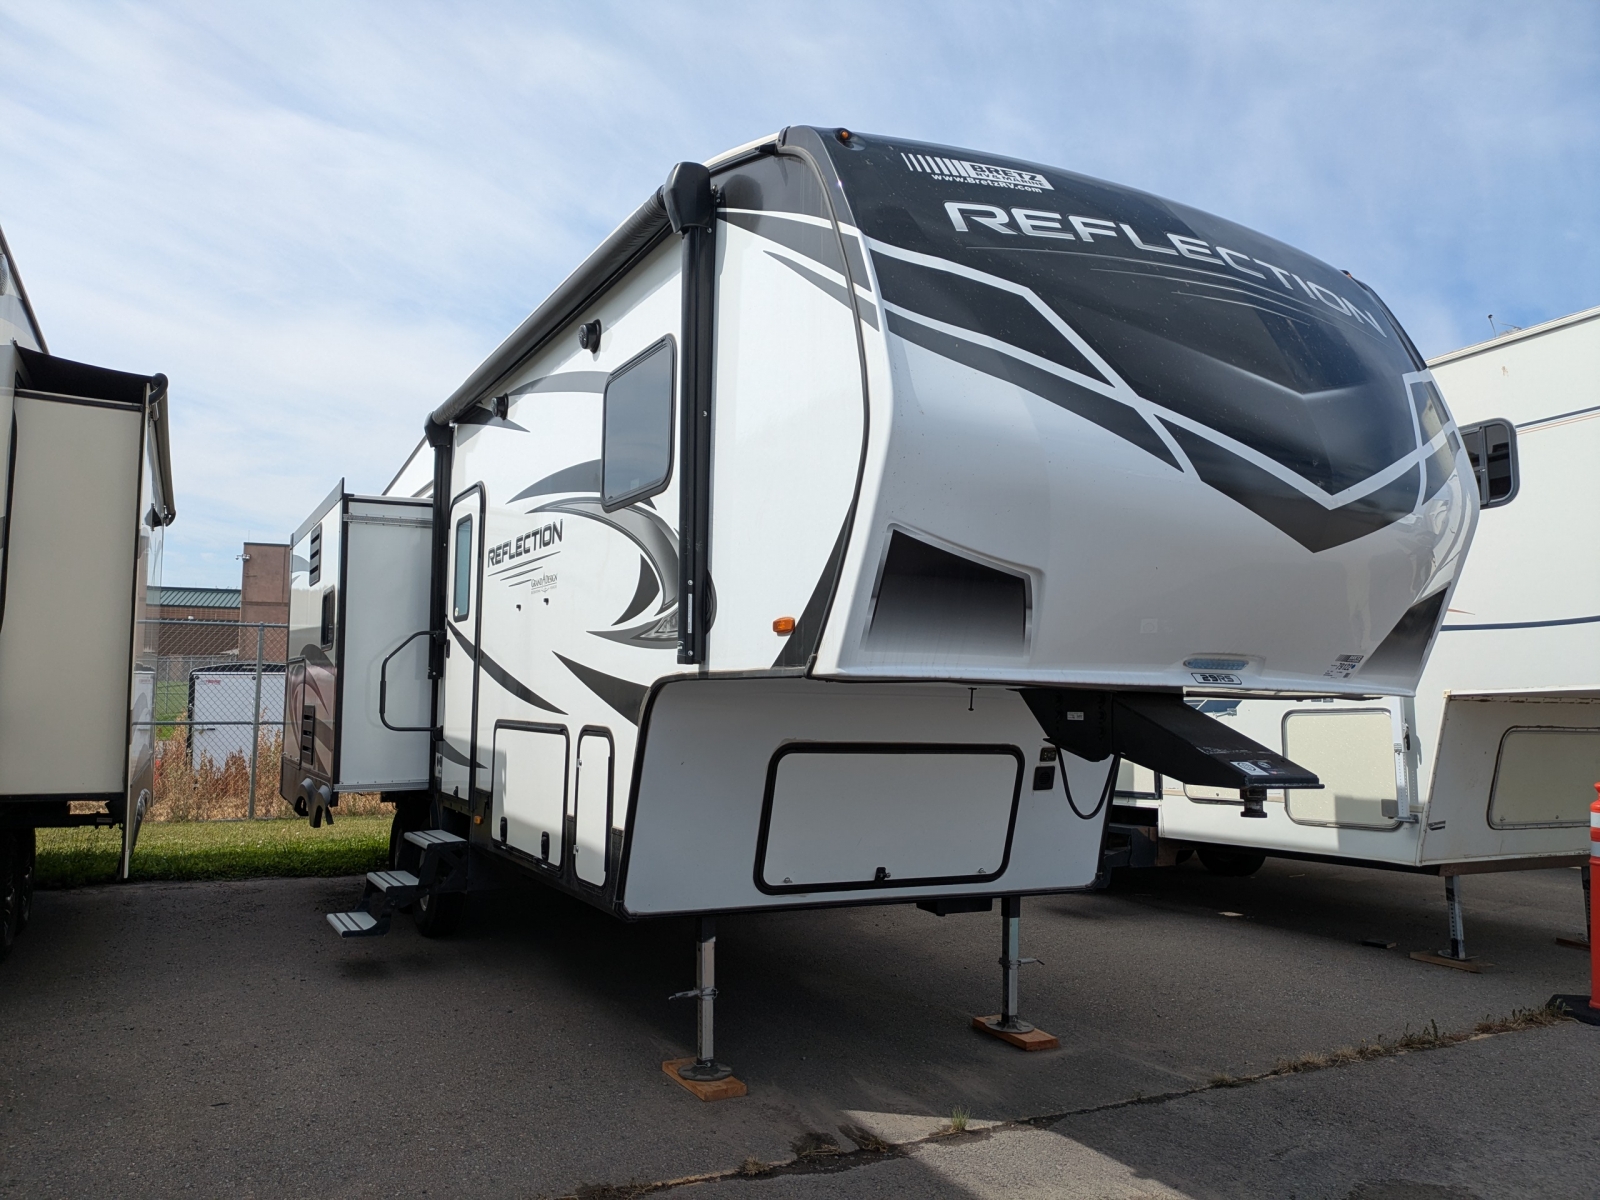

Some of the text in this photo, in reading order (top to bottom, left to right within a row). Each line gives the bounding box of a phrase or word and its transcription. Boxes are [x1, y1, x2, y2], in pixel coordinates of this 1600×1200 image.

[969, 164, 1042, 182] BRETZ
[931, 174, 1042, 193] www.BretzRV.com
[943, 201, 1387, 338] REFLECTION
[487, 518, 563, 567] REFLECTION
[1200, 674, 1235, 683] 29RS
